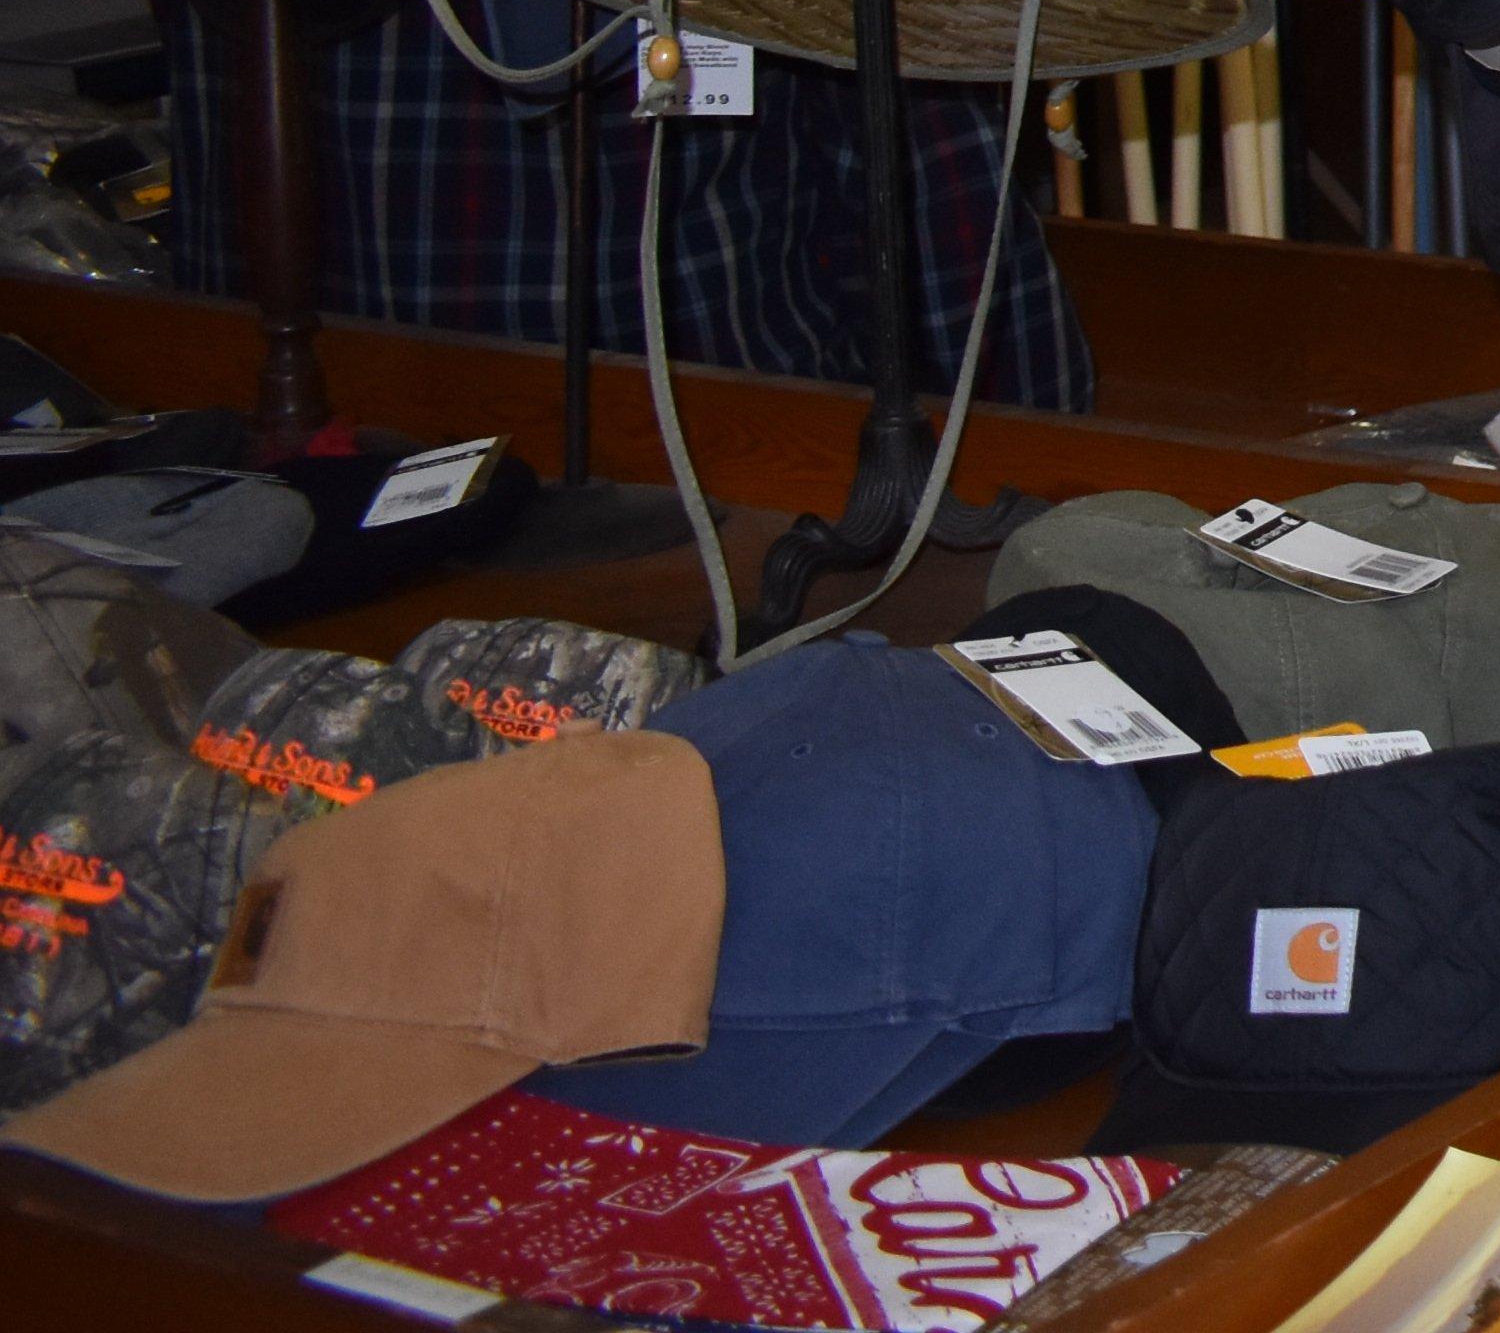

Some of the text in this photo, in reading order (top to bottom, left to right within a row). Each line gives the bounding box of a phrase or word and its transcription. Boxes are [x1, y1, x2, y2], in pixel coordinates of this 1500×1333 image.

[994, 656, 1063, 672] carhartt
[273, 740, 352, 787] Sons
[20, 832, 103, 885] Sons
[1265, 987, 1338, 1002] carhartt
